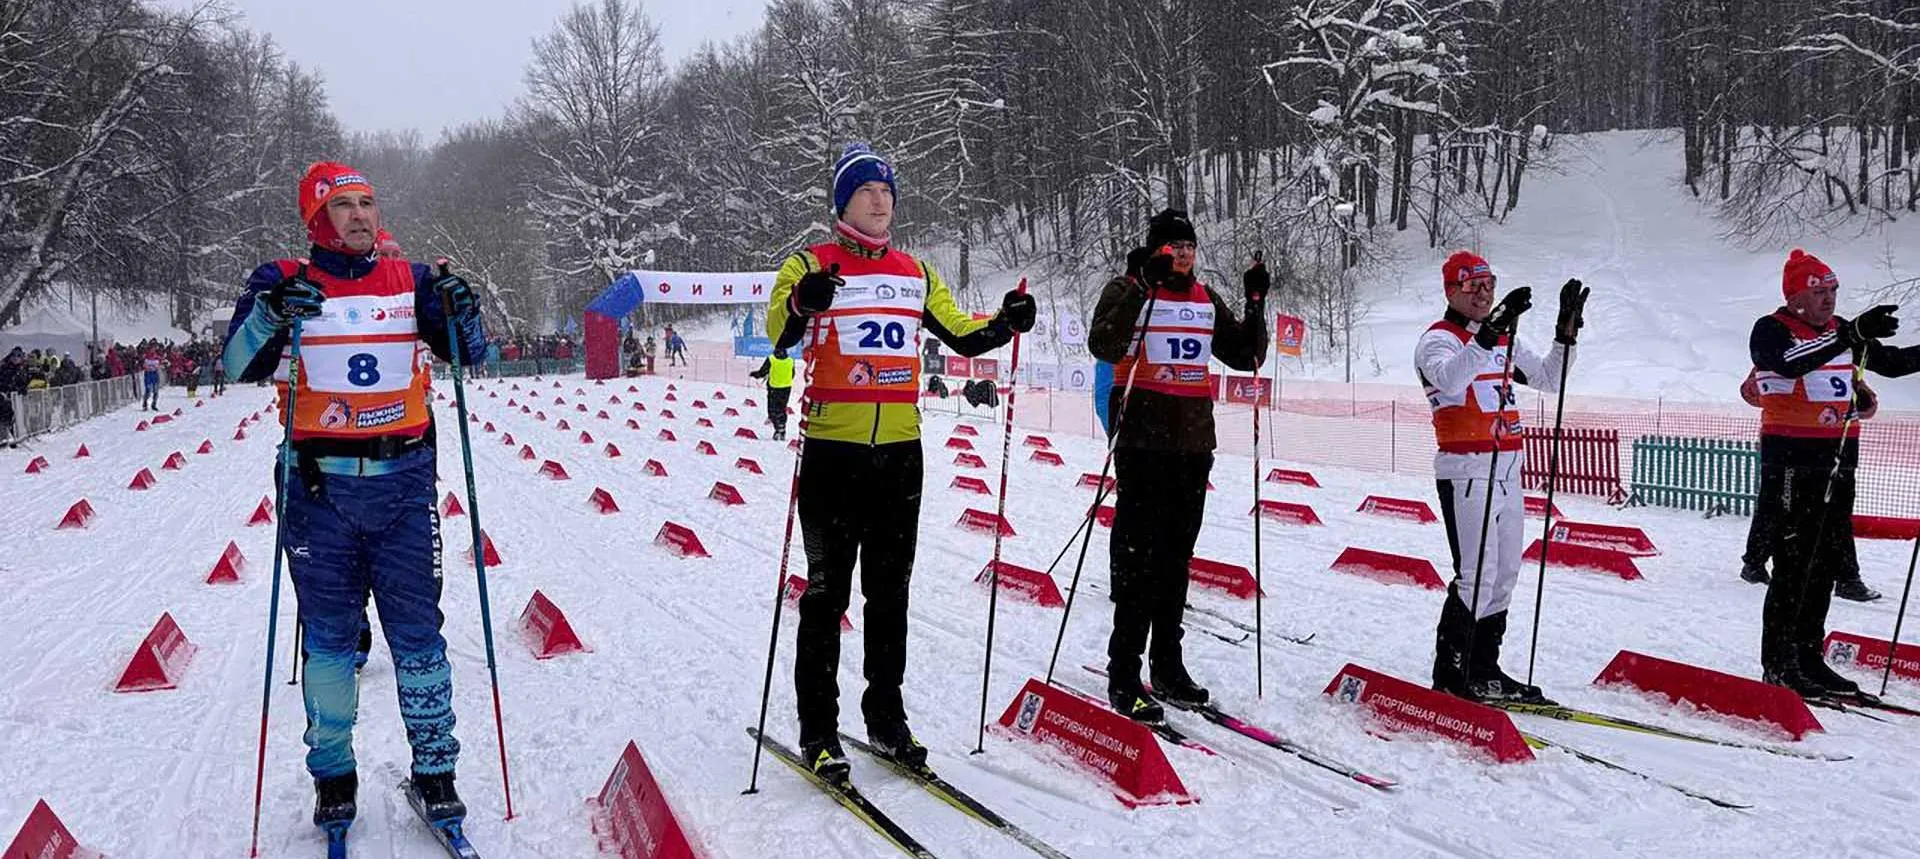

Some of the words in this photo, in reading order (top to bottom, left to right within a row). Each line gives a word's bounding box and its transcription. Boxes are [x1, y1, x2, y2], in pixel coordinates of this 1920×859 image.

[659, 282, 762, 296] ФИНИ
[857, 321, 906, 350] 20
[1167, 338, 1202, 360] 19
[347, 353, 381, 387] 8
[1829, 376, 1847, 397] 9
[357, 412, 405, 428] МАРАФОН
[358, 403, 405, 421] ЛЫЖНЫЙ
[428, 502, 442, 578] ЯМБУРГ
[1866, 653, 1920, 671] СПОРТИВ
[1370, 693, 1436, 723] СПОРТИВНАЯ
[1436, 714, 1473, 735] ШКОЛА
[1475, 726, 1496, 742] №5
[1044, 709, 1095, 741] СПОРТИВНАЯ
[1093, 730, 1123, 755] ШКОЛА
[1122, 744, 1140, 761] №5
[1036, 727, 1049, 742] ПО
[1085, 750, 1119, 775] ГОНКАМ
